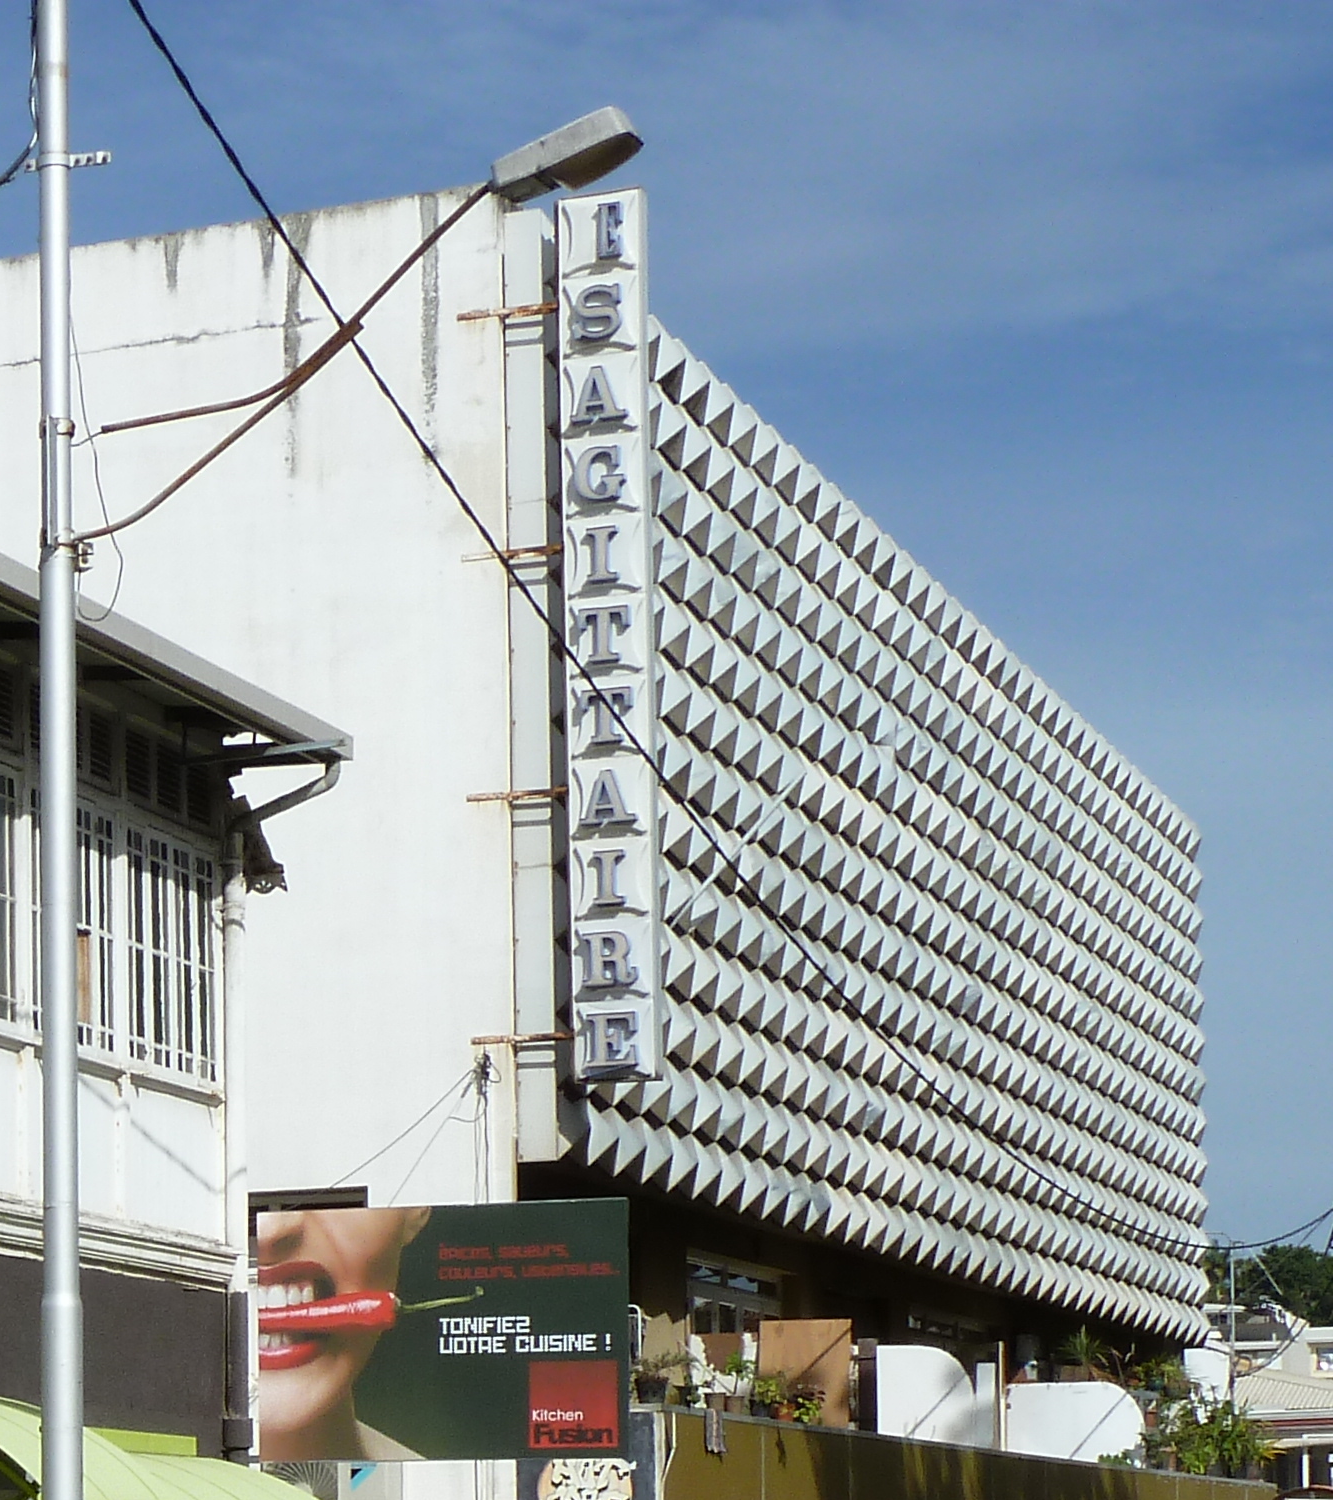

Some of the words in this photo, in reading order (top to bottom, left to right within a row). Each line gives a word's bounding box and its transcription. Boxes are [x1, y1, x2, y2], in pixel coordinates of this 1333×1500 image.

[439, 1316, 531, 1335] TONIFIEZ
[439, 1337, 507, 1354] VOTRE
[515, 1334, 598, 1353] CUISINE
[604, 1333, 613, 1352] !
[531, 1408, 584, 1422] Kitchen
[533, 1423, 614, 1445] Fusion
